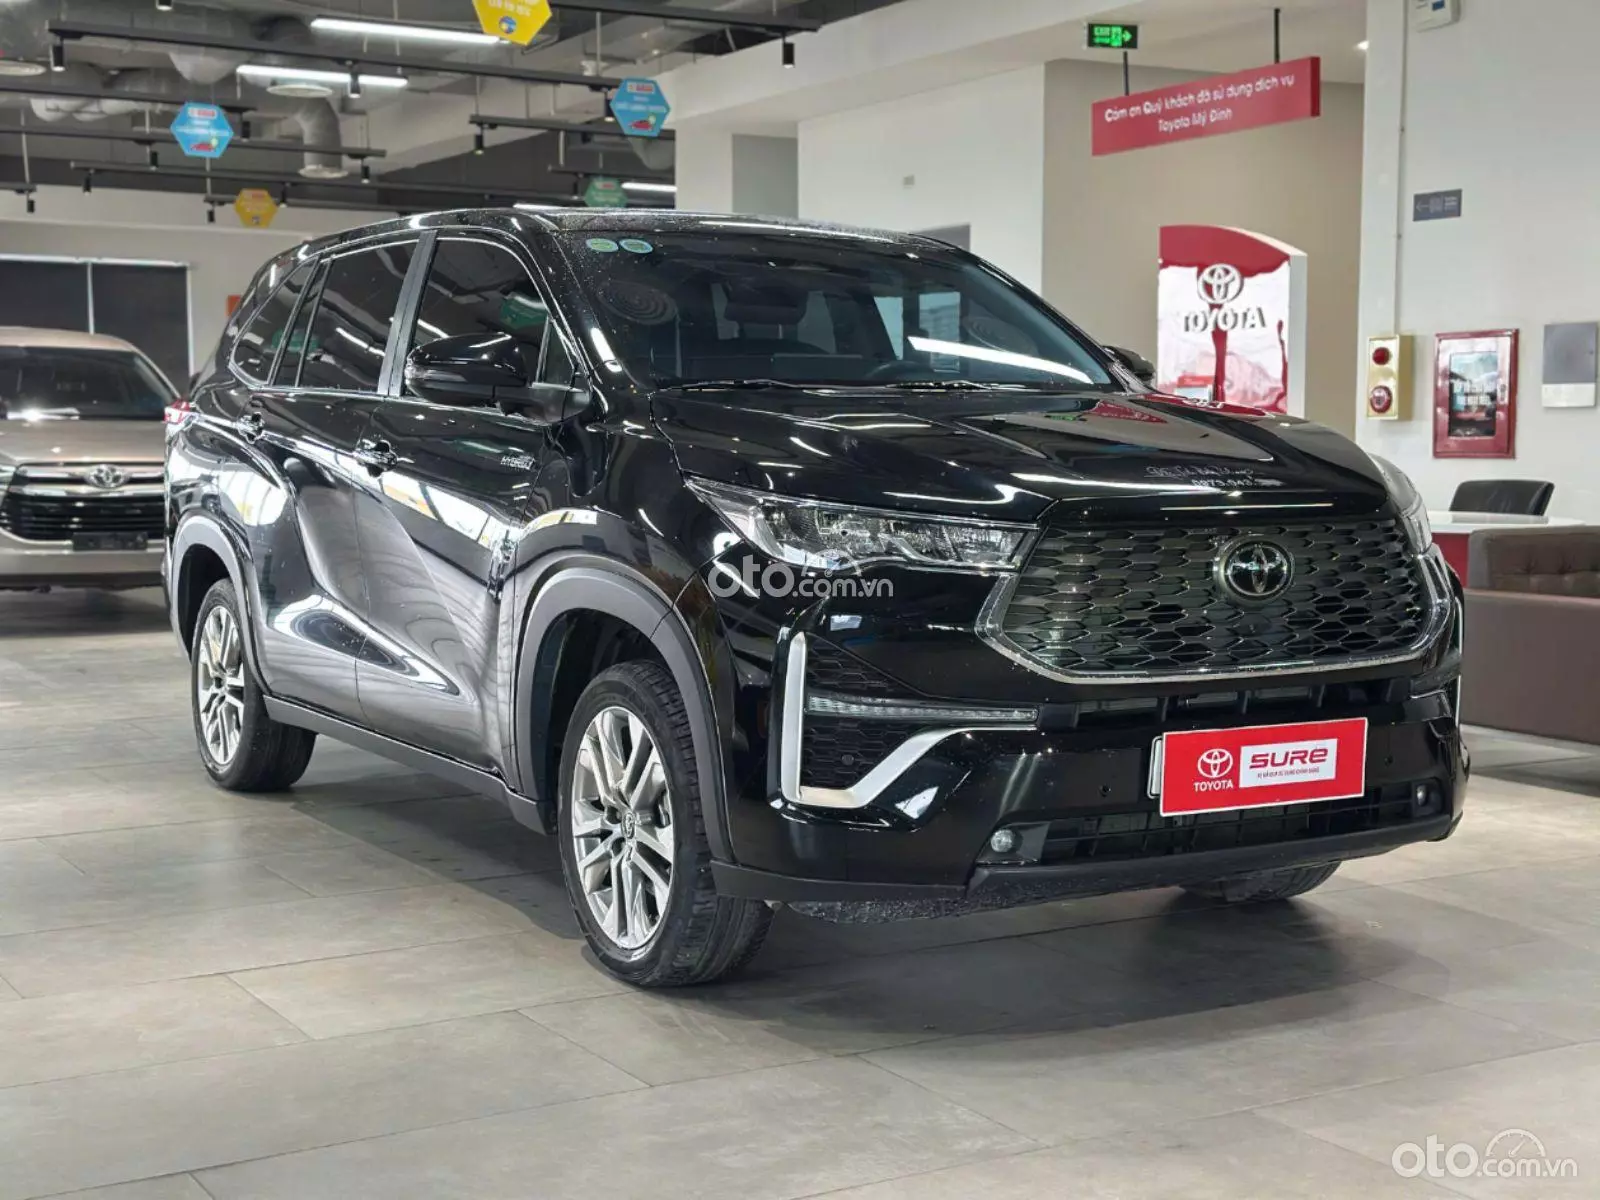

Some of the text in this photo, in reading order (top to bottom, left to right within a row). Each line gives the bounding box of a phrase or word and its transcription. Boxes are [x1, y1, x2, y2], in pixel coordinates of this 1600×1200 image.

[1165, 93, 1195, 110] khách
[1158, 115, 1191, 134] Toyota
[1180, 305, 1267, 333] TOYOTA
[1193, 780, 1234, 793] TOYOTA
